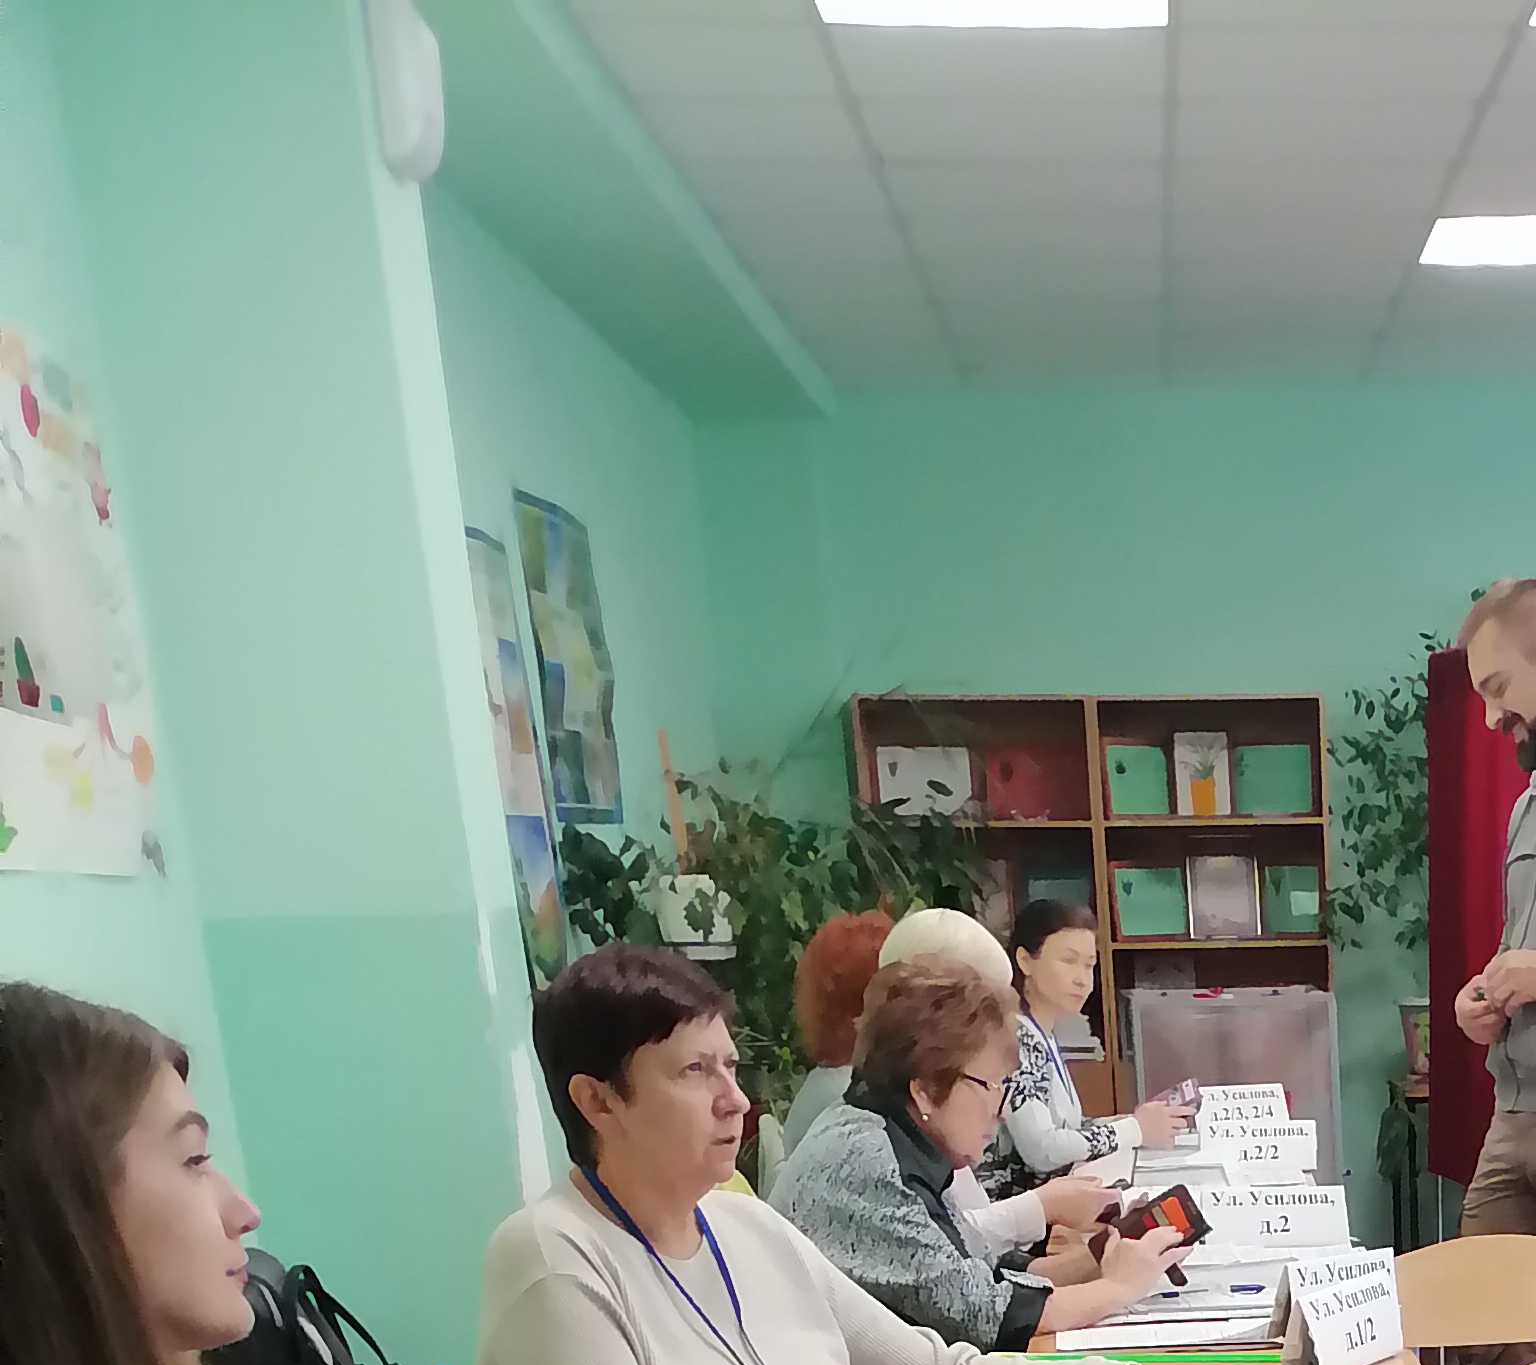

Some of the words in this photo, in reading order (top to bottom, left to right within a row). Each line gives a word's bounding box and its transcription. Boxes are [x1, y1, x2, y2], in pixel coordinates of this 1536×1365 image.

[1221, 1089, 1280, 1101] Усилова,
[1251, 1104, 1274, 1119] 2/4
[1208, 1125, 1235, 1139] Ул.
[1238, 1144, 1280, 1162] д.2/2
[1210, 1191, 1244, 1207] Ул.
[1248, 1190, 1335, 1207] Усилова,
[1259, 1215, 1291, 1236] д.2
[1296, 1266, 1323, 1288] Ул.
[1325, 1259, 1391, 1283] Усилова,
[1308, 1298, 1336, 1321] Ул.
[1332, 1281, 1391, 1313] Усилова,
[1344, 1316, 1377, 1353] д.1/2
